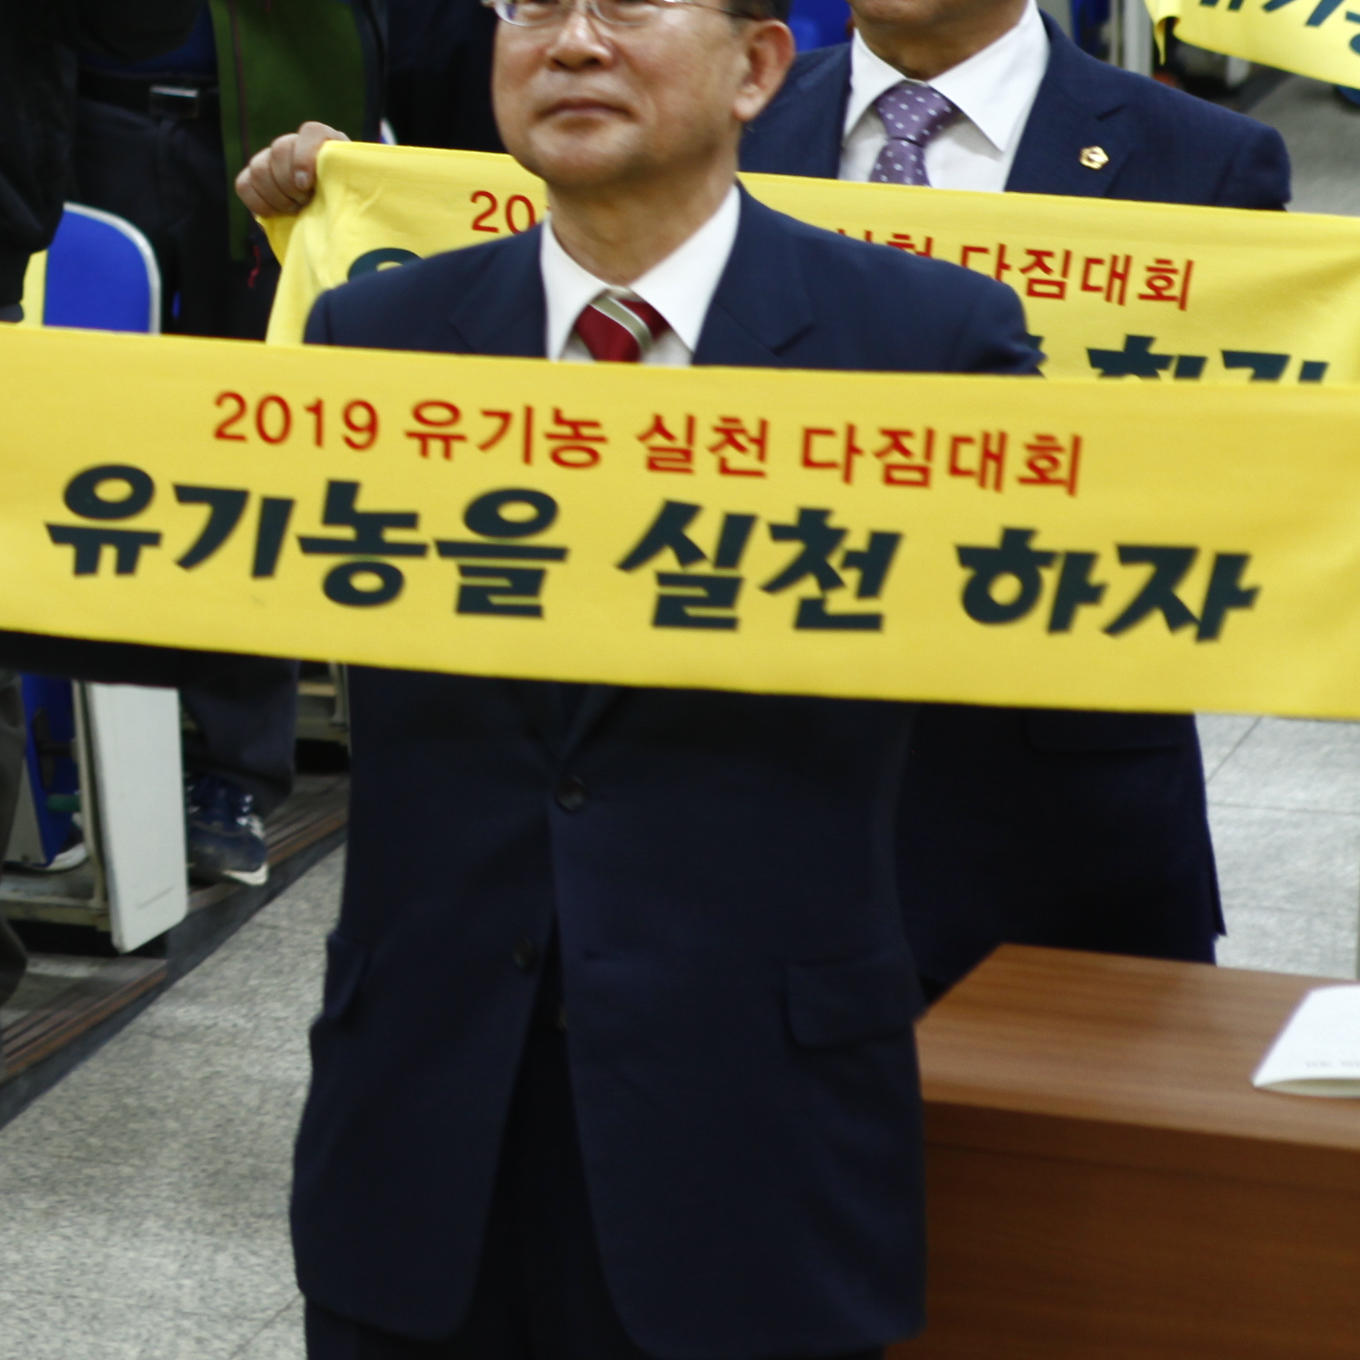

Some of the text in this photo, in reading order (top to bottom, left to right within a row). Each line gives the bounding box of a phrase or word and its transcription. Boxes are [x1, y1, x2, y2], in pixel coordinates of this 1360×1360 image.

[959, 242, 1196, 312] 다짐대회
[212, 390, 1084, 498] 2019 유기농 실천 다짐대회
[44, 462, 1262, 646] 유기농을 실천 하자
